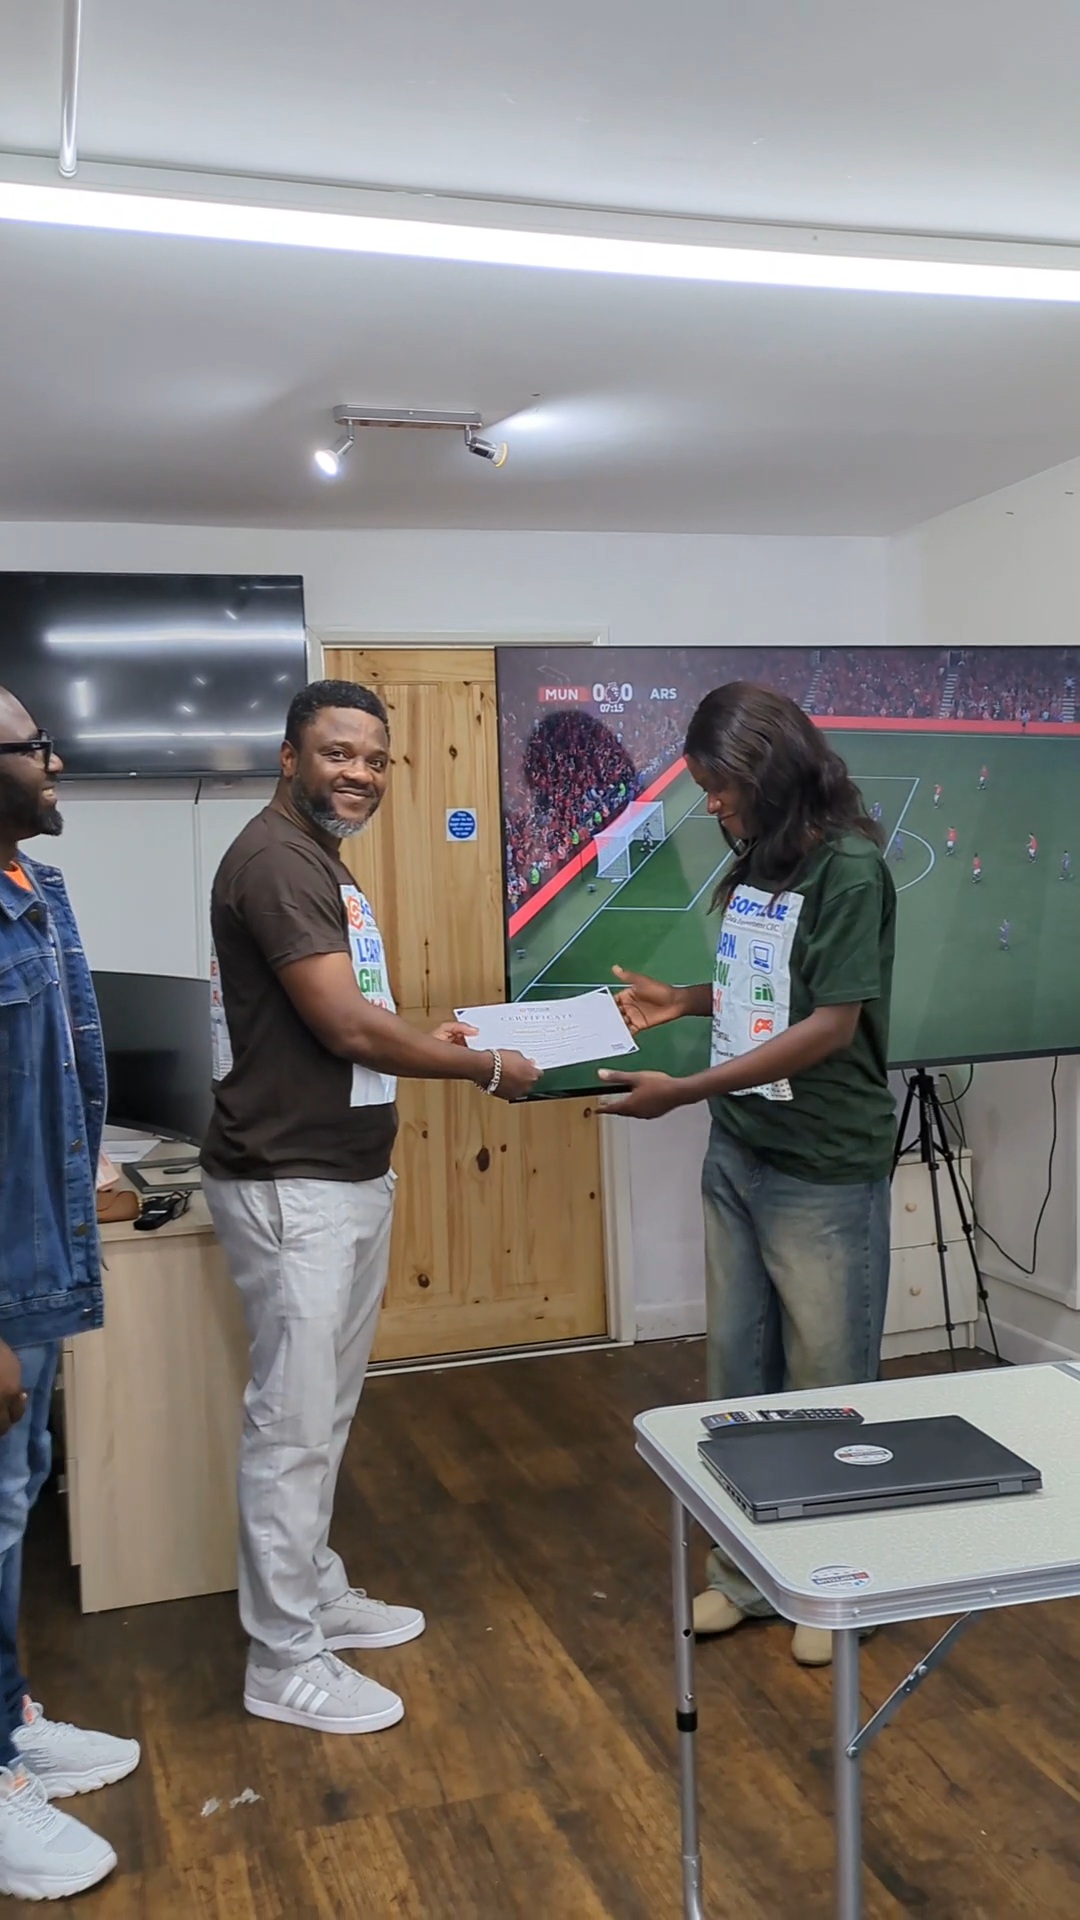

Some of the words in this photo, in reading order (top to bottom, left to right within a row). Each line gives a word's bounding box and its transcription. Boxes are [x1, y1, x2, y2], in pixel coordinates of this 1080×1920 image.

[545, 688, 579, 701] MUN
[592, 683, 605, 702] 0
[620, 683, 633, 702] 0
[649, 688, 678, 700] ARS
[600, 703, 625, 713] 07:15
